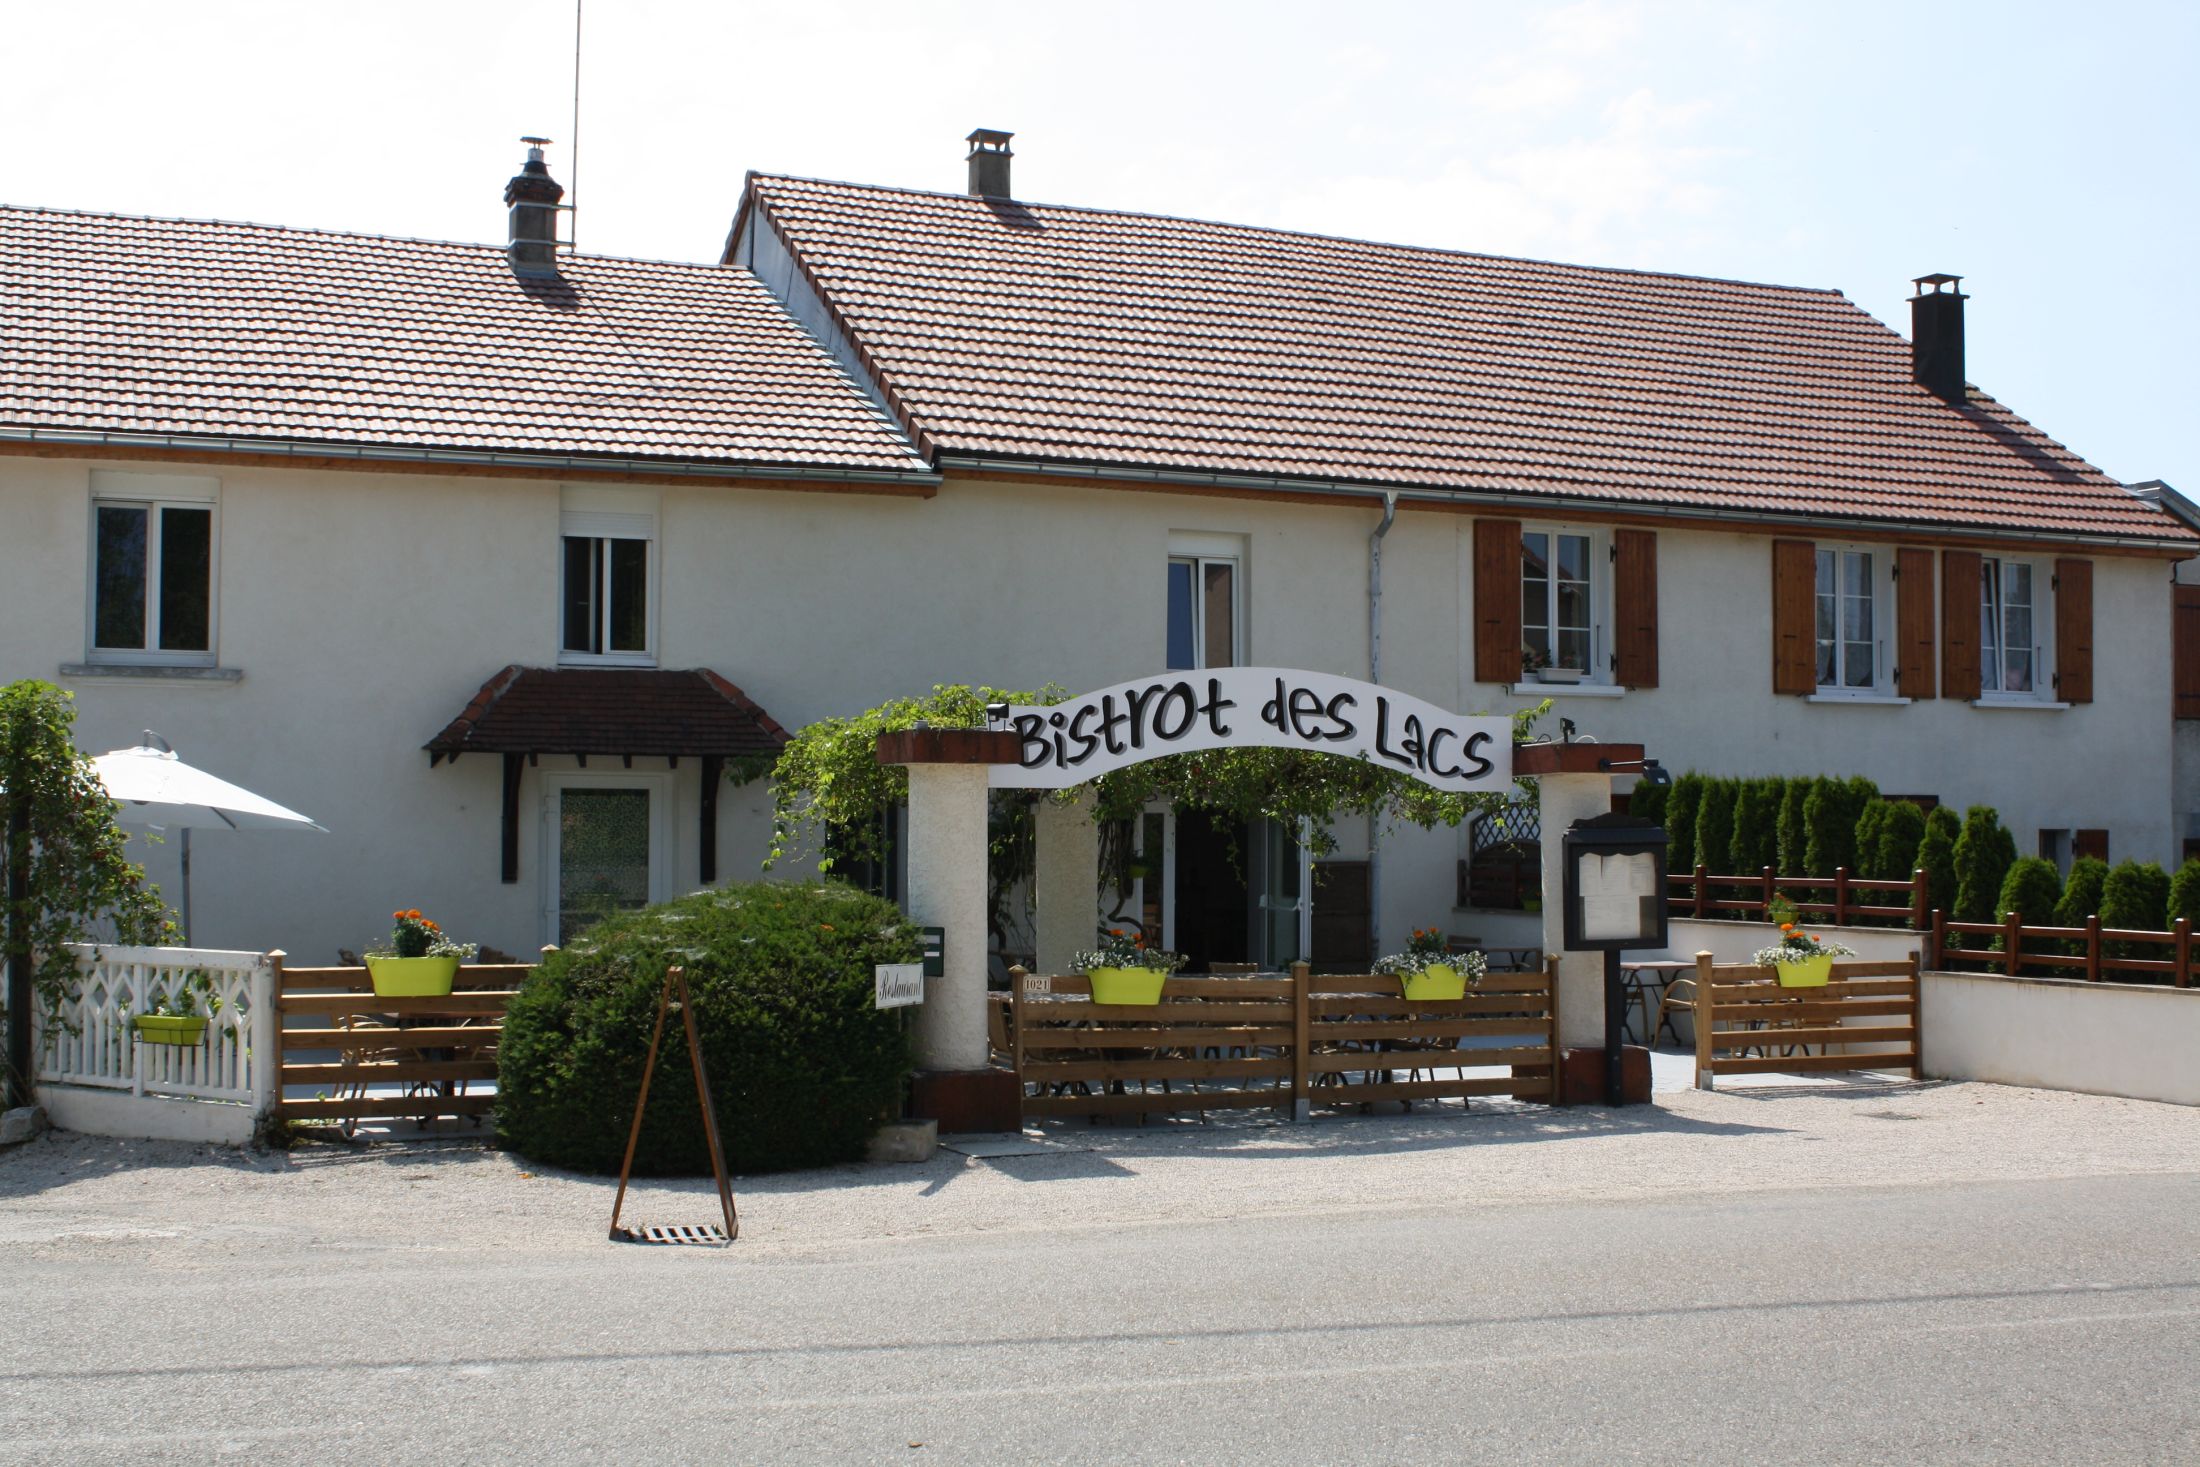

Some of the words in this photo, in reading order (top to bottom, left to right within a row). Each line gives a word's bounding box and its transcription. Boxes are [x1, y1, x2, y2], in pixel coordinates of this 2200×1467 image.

[1013, 677, 1235, 768] Bistrot
[1261, 677, 1358, 740] des
[1376, 696, 1494, 781] Lacs
[879, 969, 922, 1001] Restaurant
[1025, 979, 1048, 990] 1021
